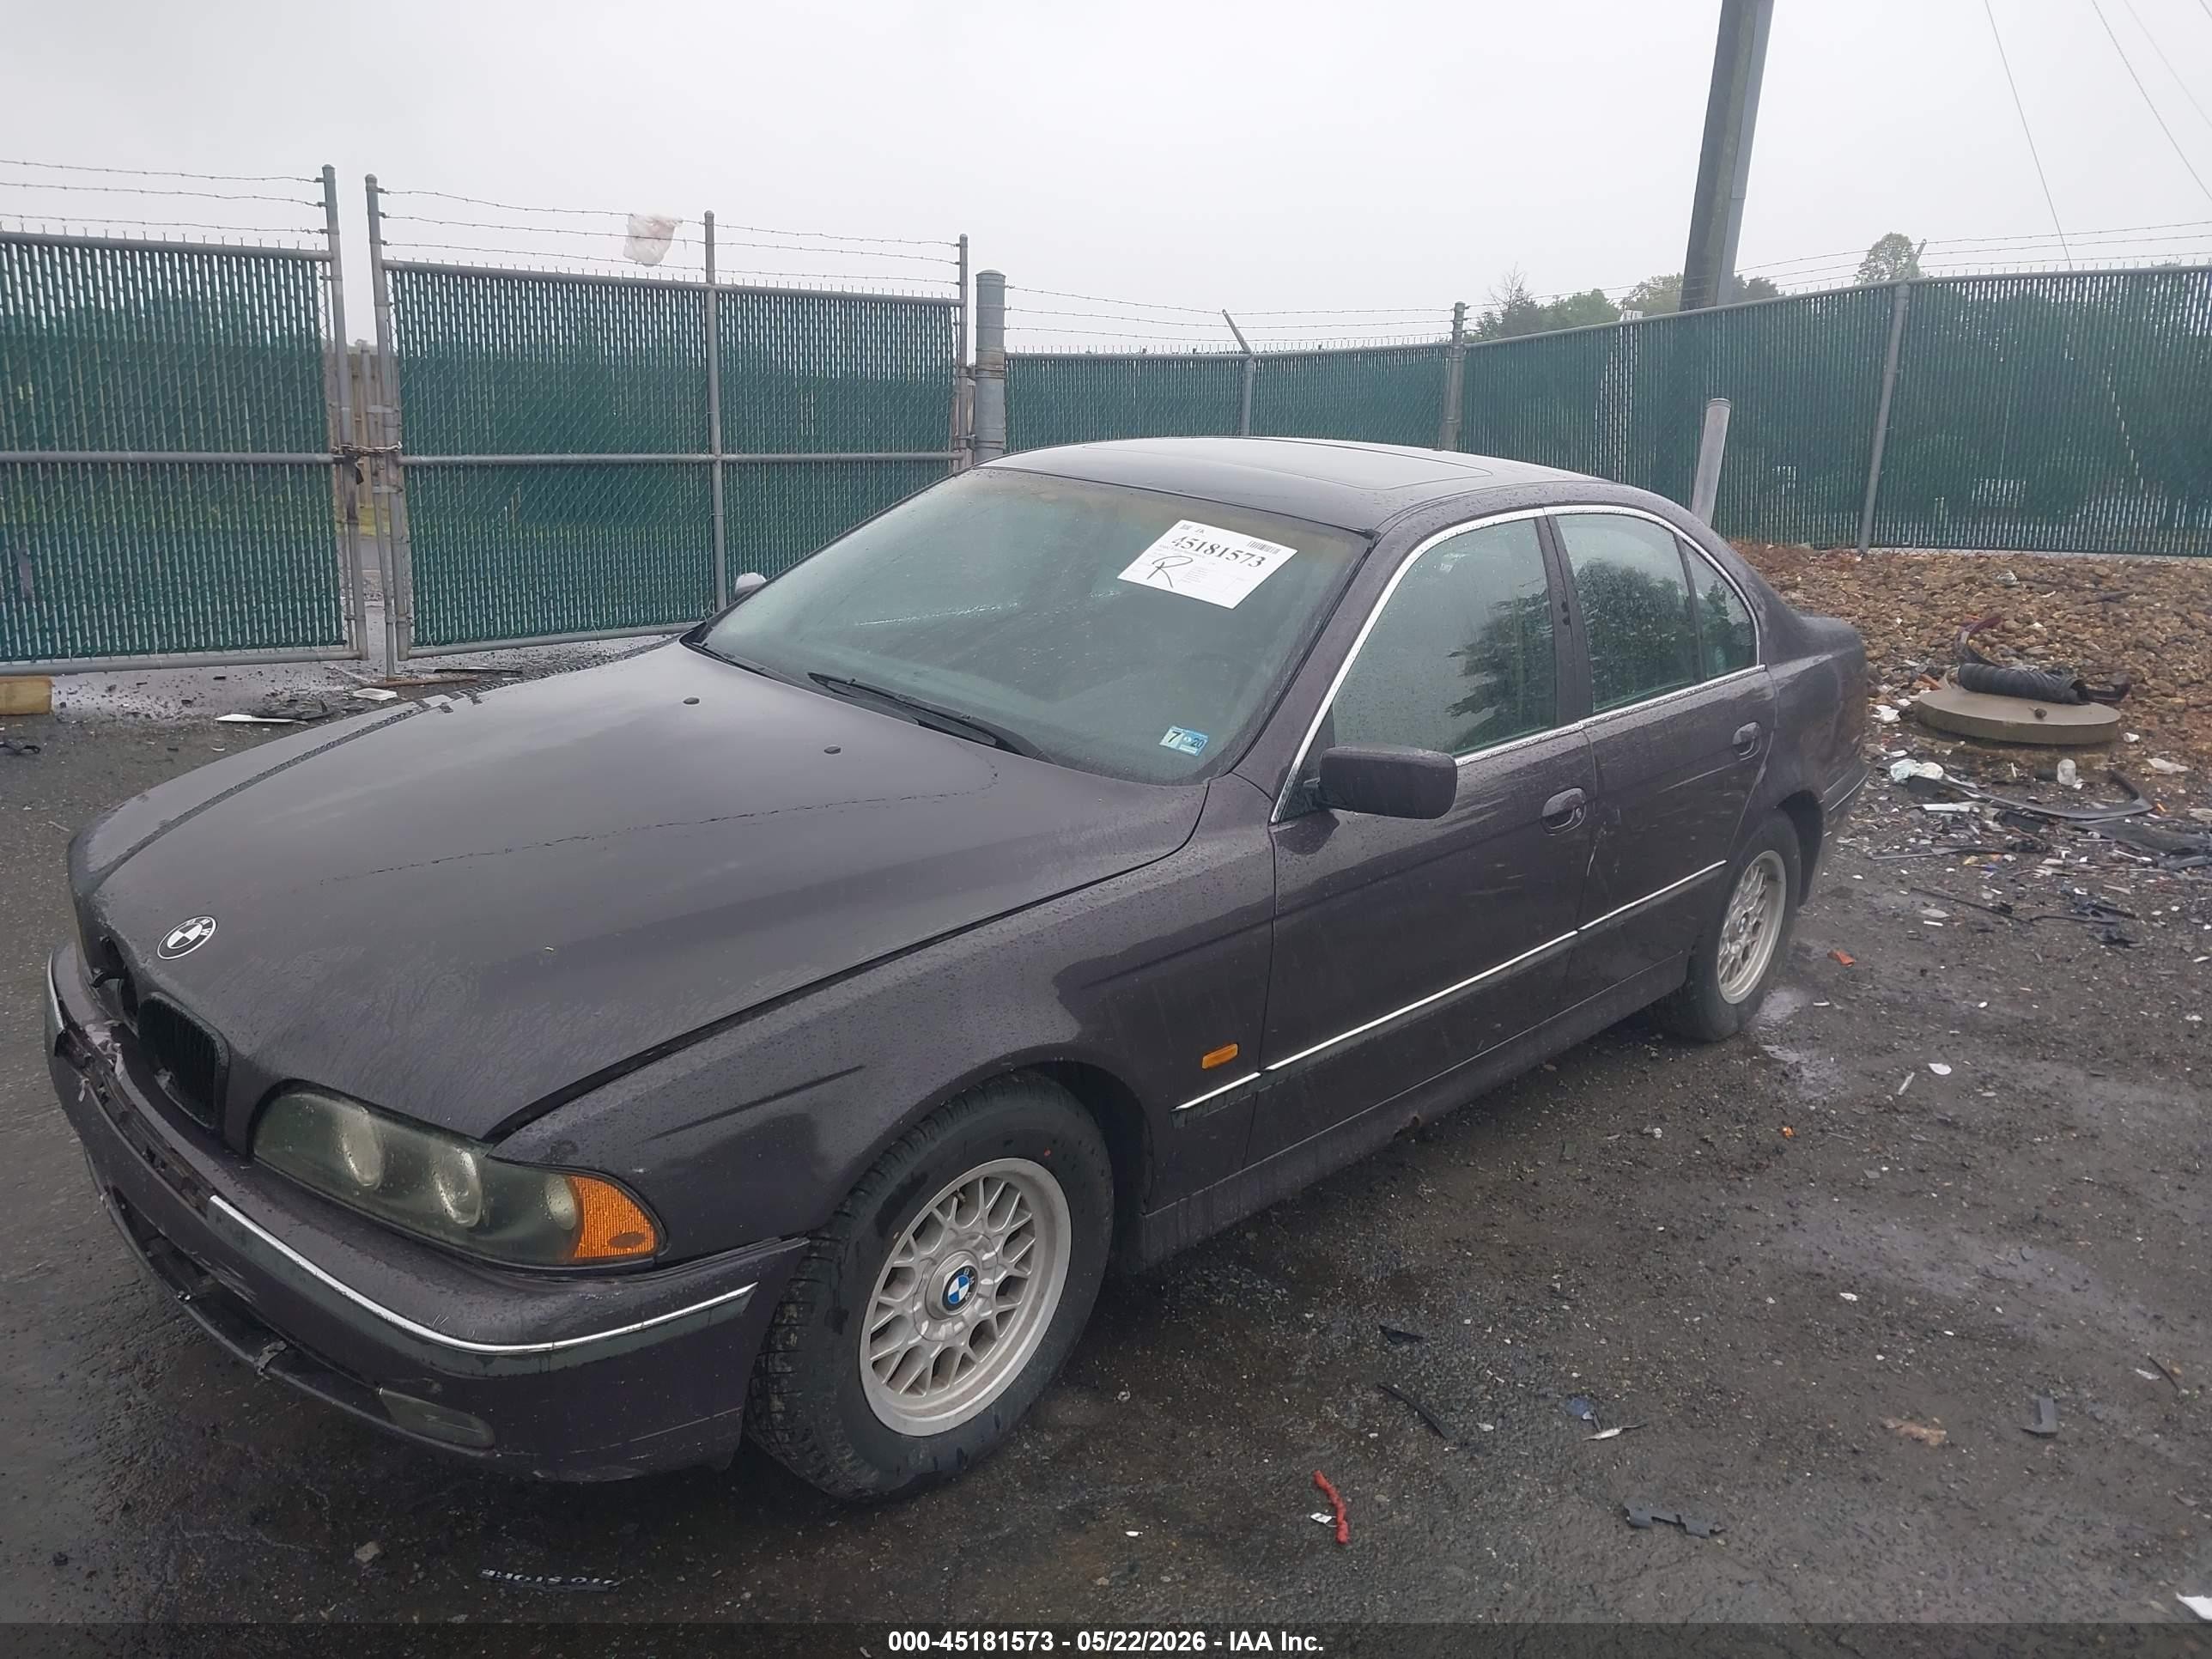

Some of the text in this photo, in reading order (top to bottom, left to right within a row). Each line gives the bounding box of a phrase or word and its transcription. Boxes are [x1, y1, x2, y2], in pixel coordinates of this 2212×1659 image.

[1170, 535, 1267, 568] 45181573
[1146, 556, 1194, 588] R
[1168, 730, 1182, 743] 7
